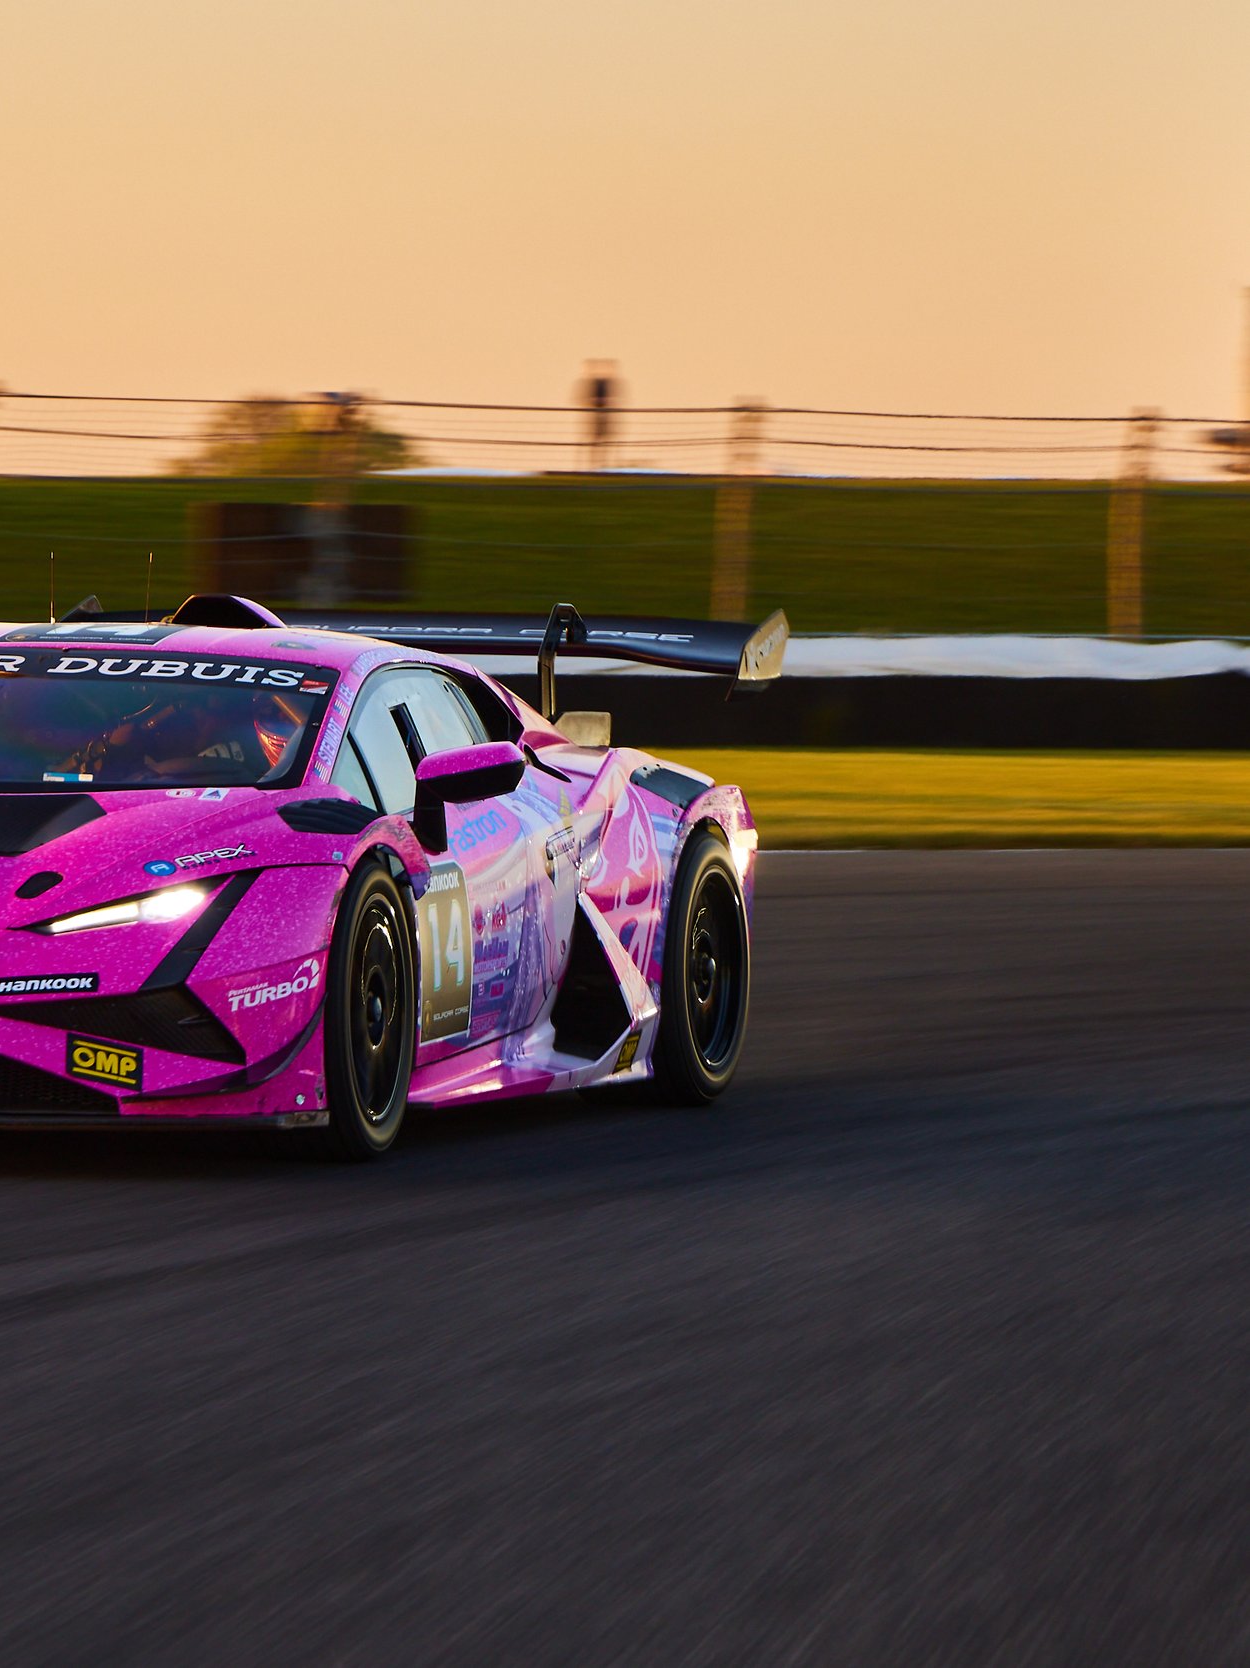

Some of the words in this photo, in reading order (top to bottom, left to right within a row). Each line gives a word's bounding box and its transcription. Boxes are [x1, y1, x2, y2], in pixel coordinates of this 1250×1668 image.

[47, 657, 305, 687] DUBUIS
[318, 717, 343, 766] STEWART
[175, 844, 253, 868] APEX
[428, 899, 465, 992] 14
[228, 977, 309, 1012] TURBO
[72, 1047, 138, 1077] OMP
